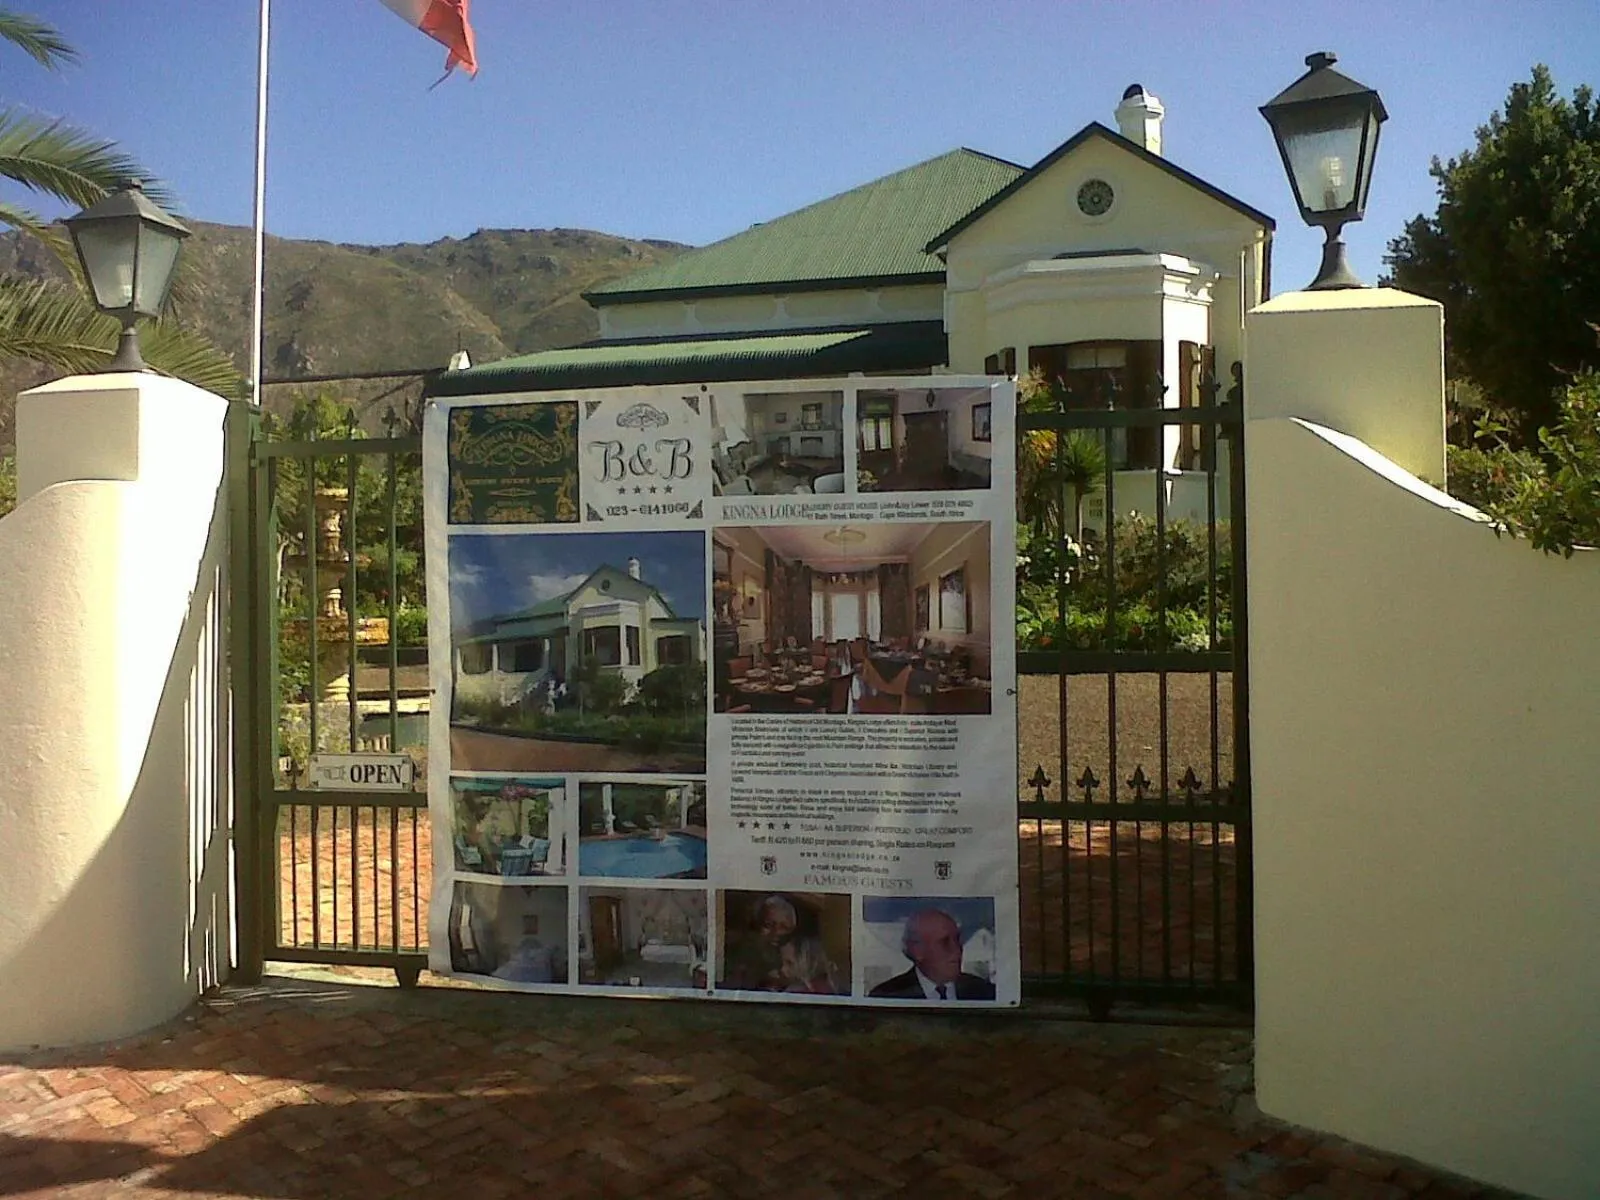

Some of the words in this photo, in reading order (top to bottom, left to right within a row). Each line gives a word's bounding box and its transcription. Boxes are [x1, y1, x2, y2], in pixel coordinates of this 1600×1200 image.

[587, 438, 693, 483] B&B
[722, 503, 767, 520] KINGNA
[769, 503, 808, 519] LODGE
[350, 764, 401, 784] OPEN
[861, 878, 912, 889] GUESTS
